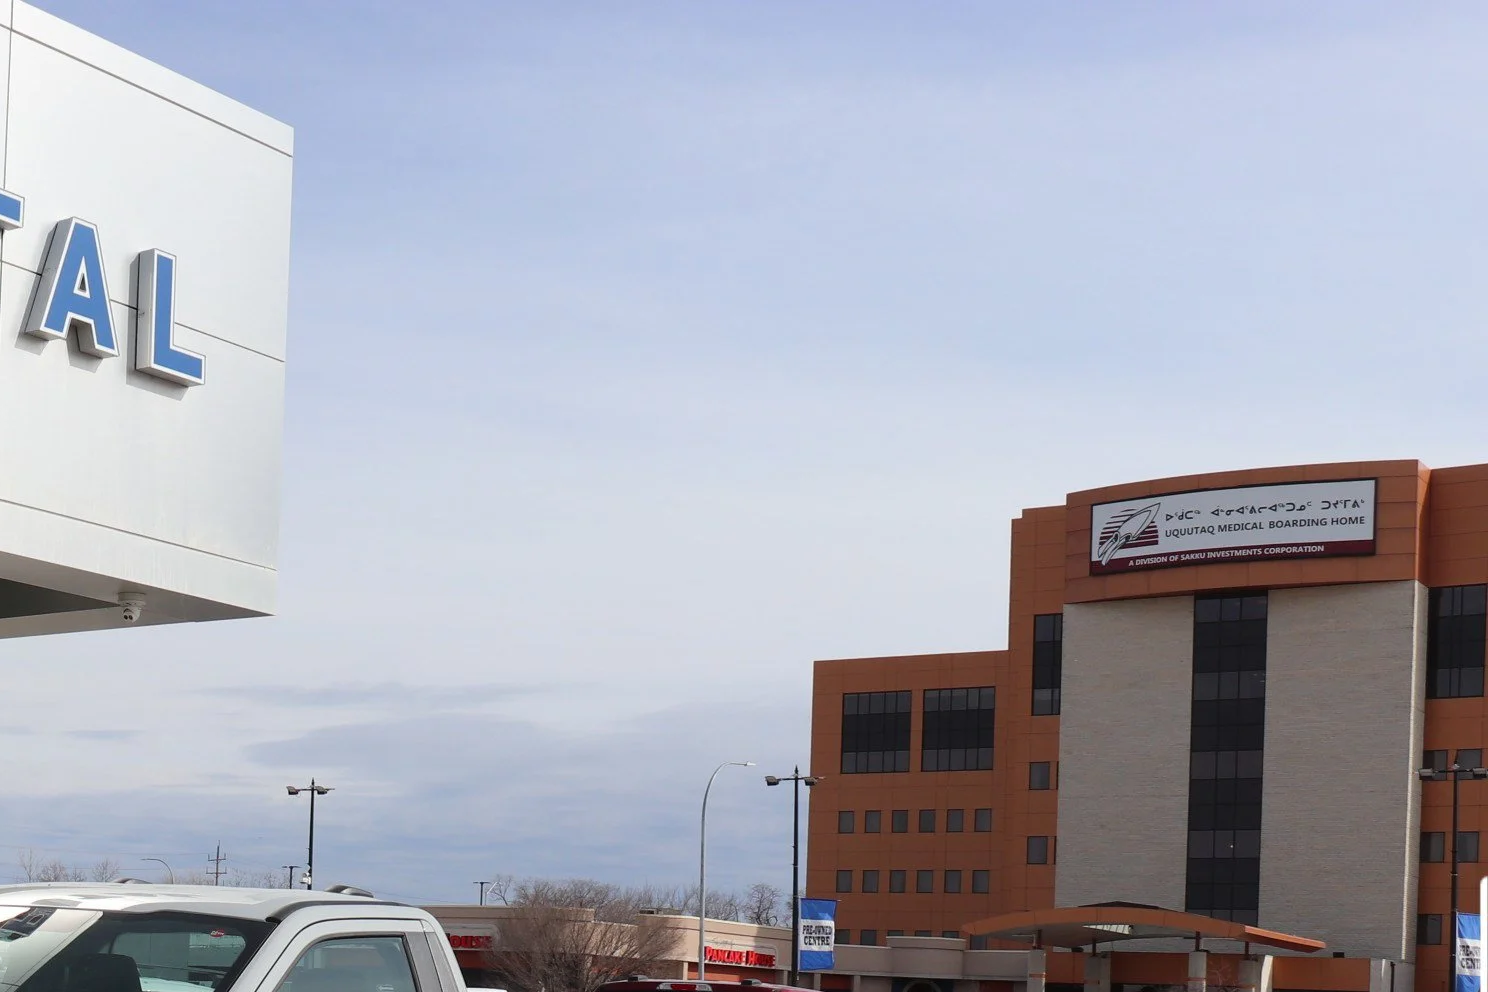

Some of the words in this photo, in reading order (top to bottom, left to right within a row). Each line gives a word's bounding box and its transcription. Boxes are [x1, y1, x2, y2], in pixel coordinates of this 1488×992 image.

[1165, 525, 1215, 538] UQUUTAQ
[1217, 521, 1264, 533] MEDICAL
[1268, 517, 1328, 529] BOARDING
[1331, 516, 1365, 525] HOME
[1136, 556, 1168, 566] DIVISION
[1180, 552, 1206, 561] SAKKU
[1207, 548, 1262, 559] INVESTMENTS
[1264, 545, 1325, 555] CORPORATION
[802, 925, 833, 935] PRE-OWNED
[803, 936, 830, 946] CENTRE
